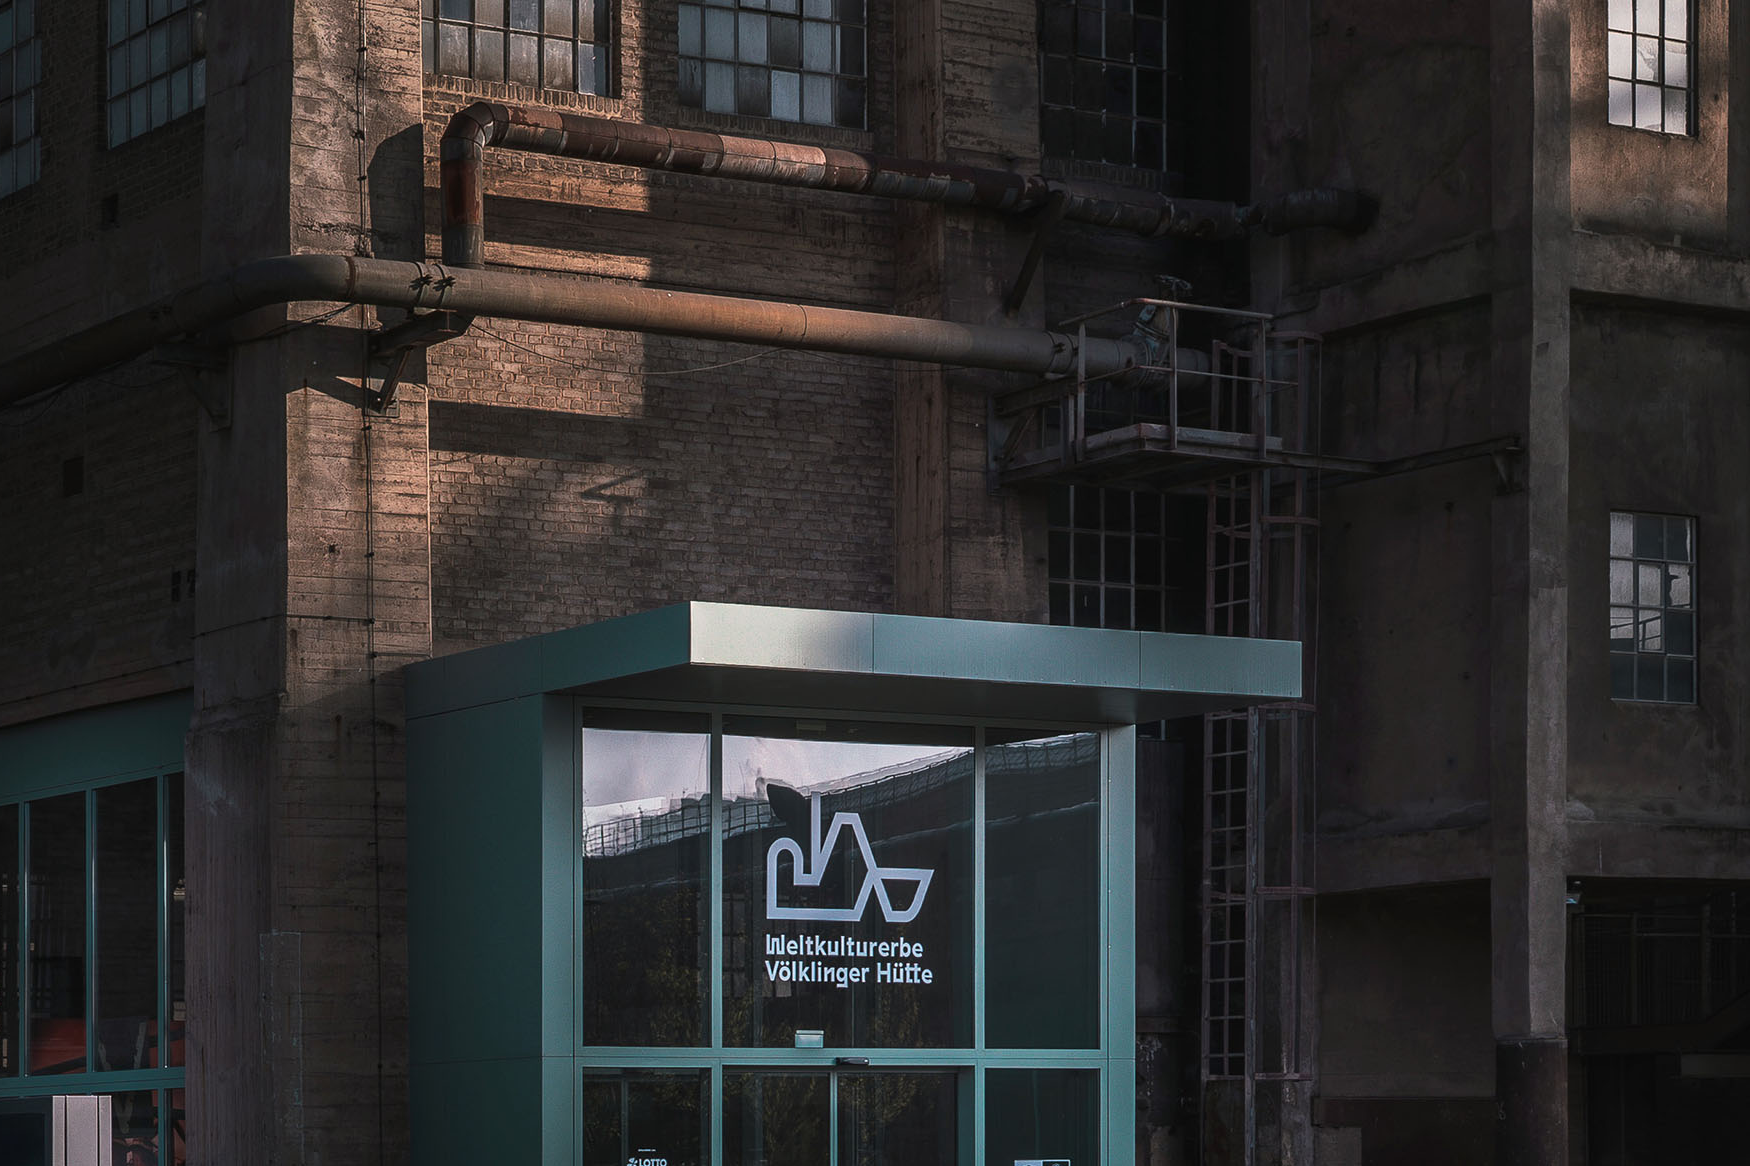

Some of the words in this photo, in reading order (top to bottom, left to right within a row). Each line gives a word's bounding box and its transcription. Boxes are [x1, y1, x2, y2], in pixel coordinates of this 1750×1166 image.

[766, 934, 923, 958] Weltkulturerbe
[765, 960, 870, 988] Völklinger
[877, 962, 933, 984] Hütte
